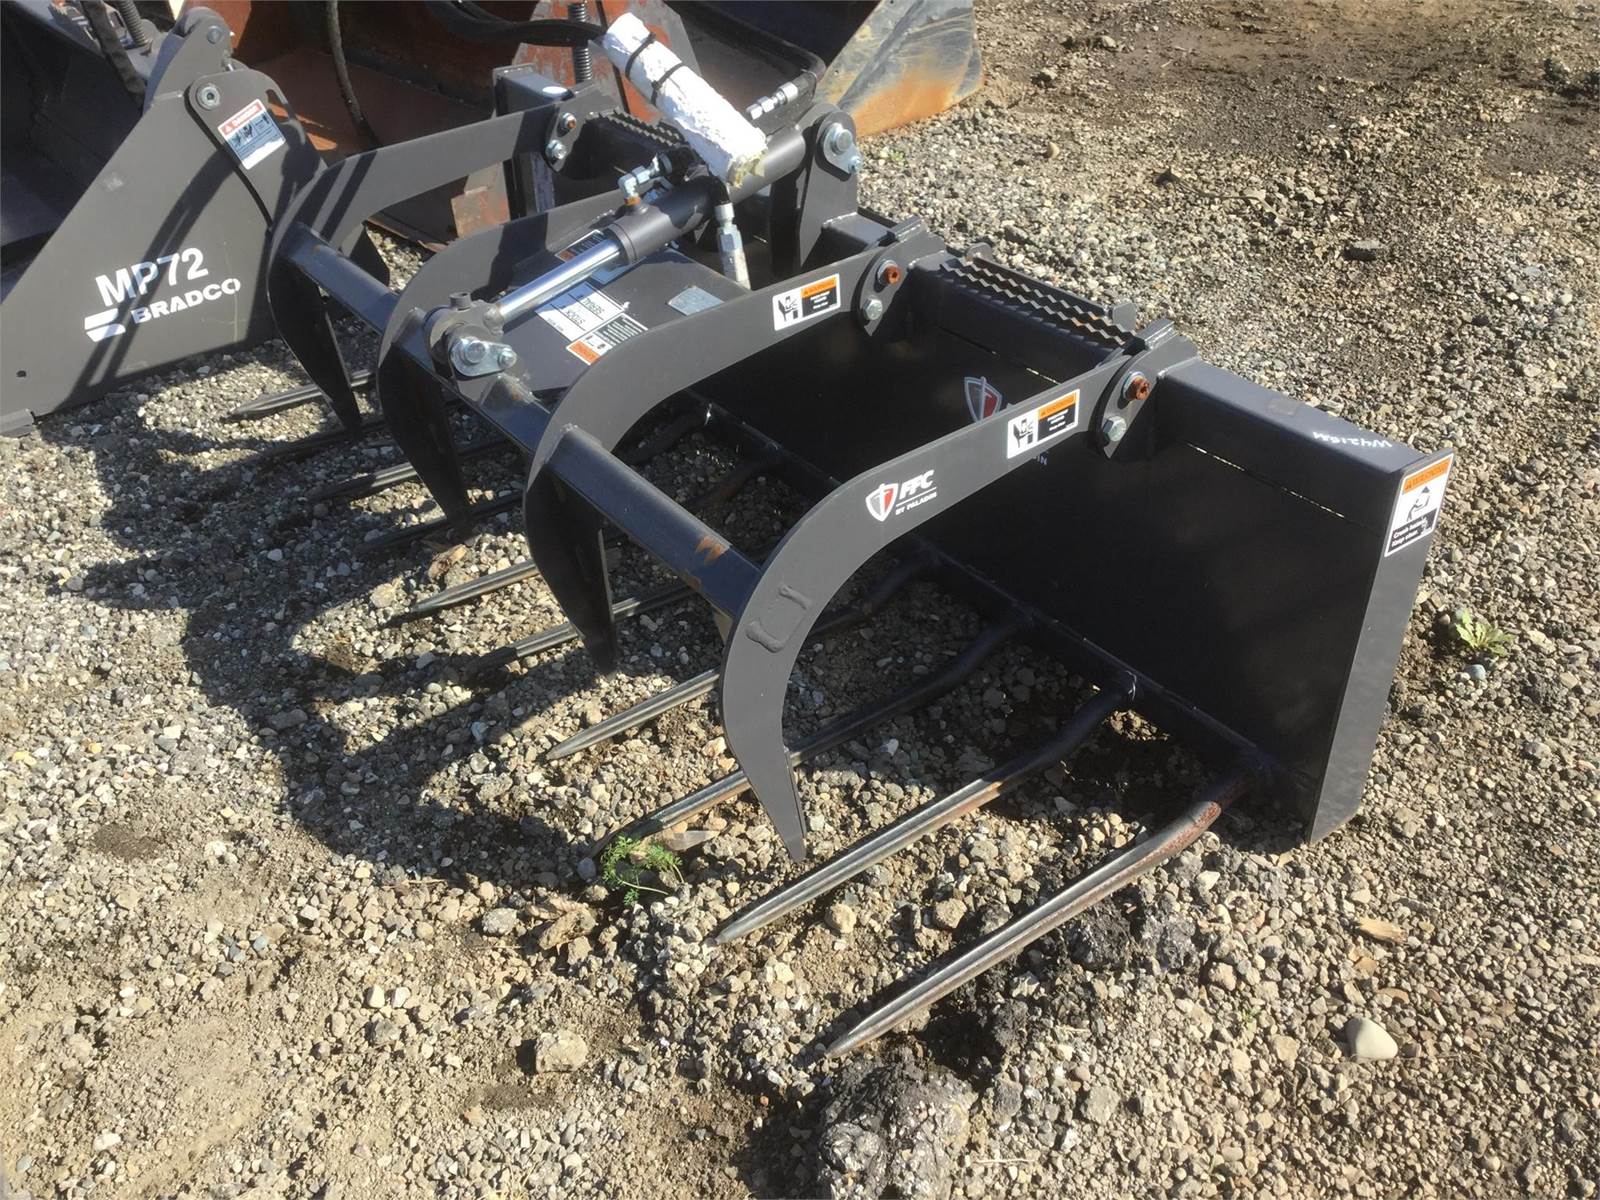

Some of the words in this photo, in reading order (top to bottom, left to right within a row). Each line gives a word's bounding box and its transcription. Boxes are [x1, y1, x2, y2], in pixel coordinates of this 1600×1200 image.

[95, 248, 209, 307] MP72
[130, 278, 241, 324] BRADCO
[899, 469, 935, 500] FFC
